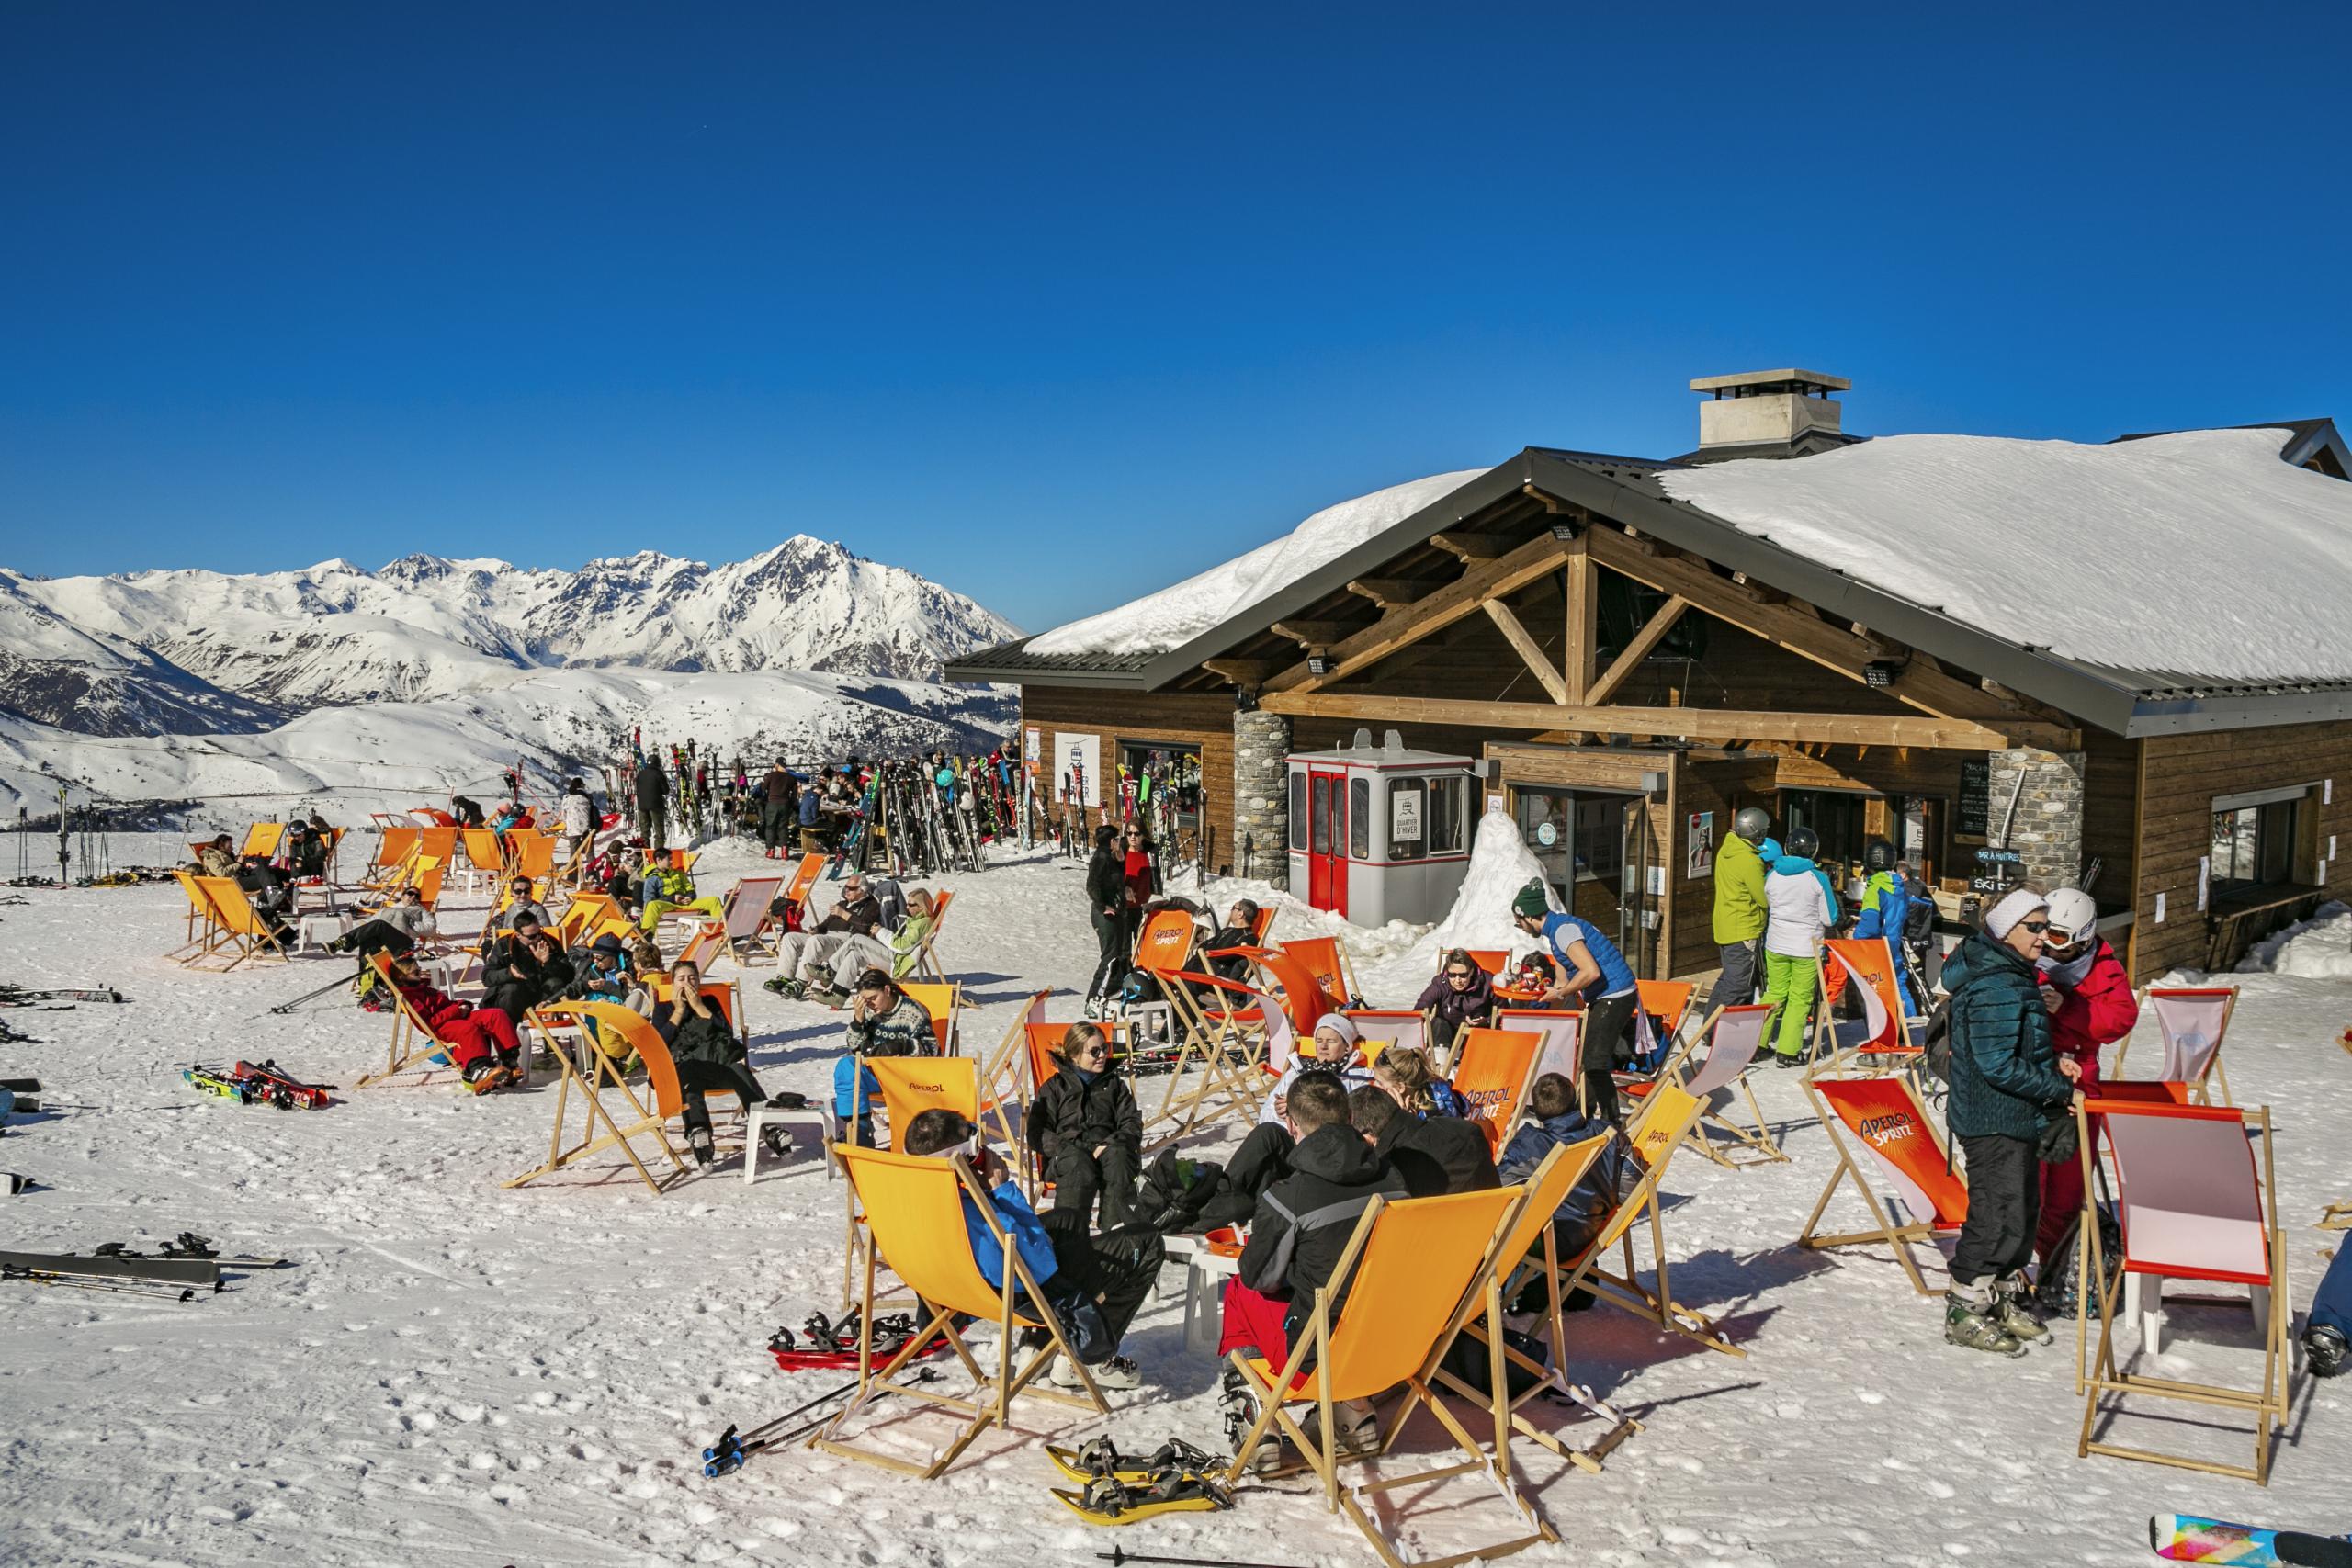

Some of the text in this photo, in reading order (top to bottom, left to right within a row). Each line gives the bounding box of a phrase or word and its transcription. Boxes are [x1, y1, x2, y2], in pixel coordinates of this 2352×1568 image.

[1396, 818, 1418, 827] QUARTIER
[1396, 826, 1418, 835] D'HIVER
[1153, 928, 1184, 940] APEROL
[1155, 936, 1179, 945] SPRITZ
[1465, 1086, 1510, 1106] APEROL
[1860, 1111, 1915, 1140] APEROL
[1873, 1124, 1915, 1147] SPRITZ
